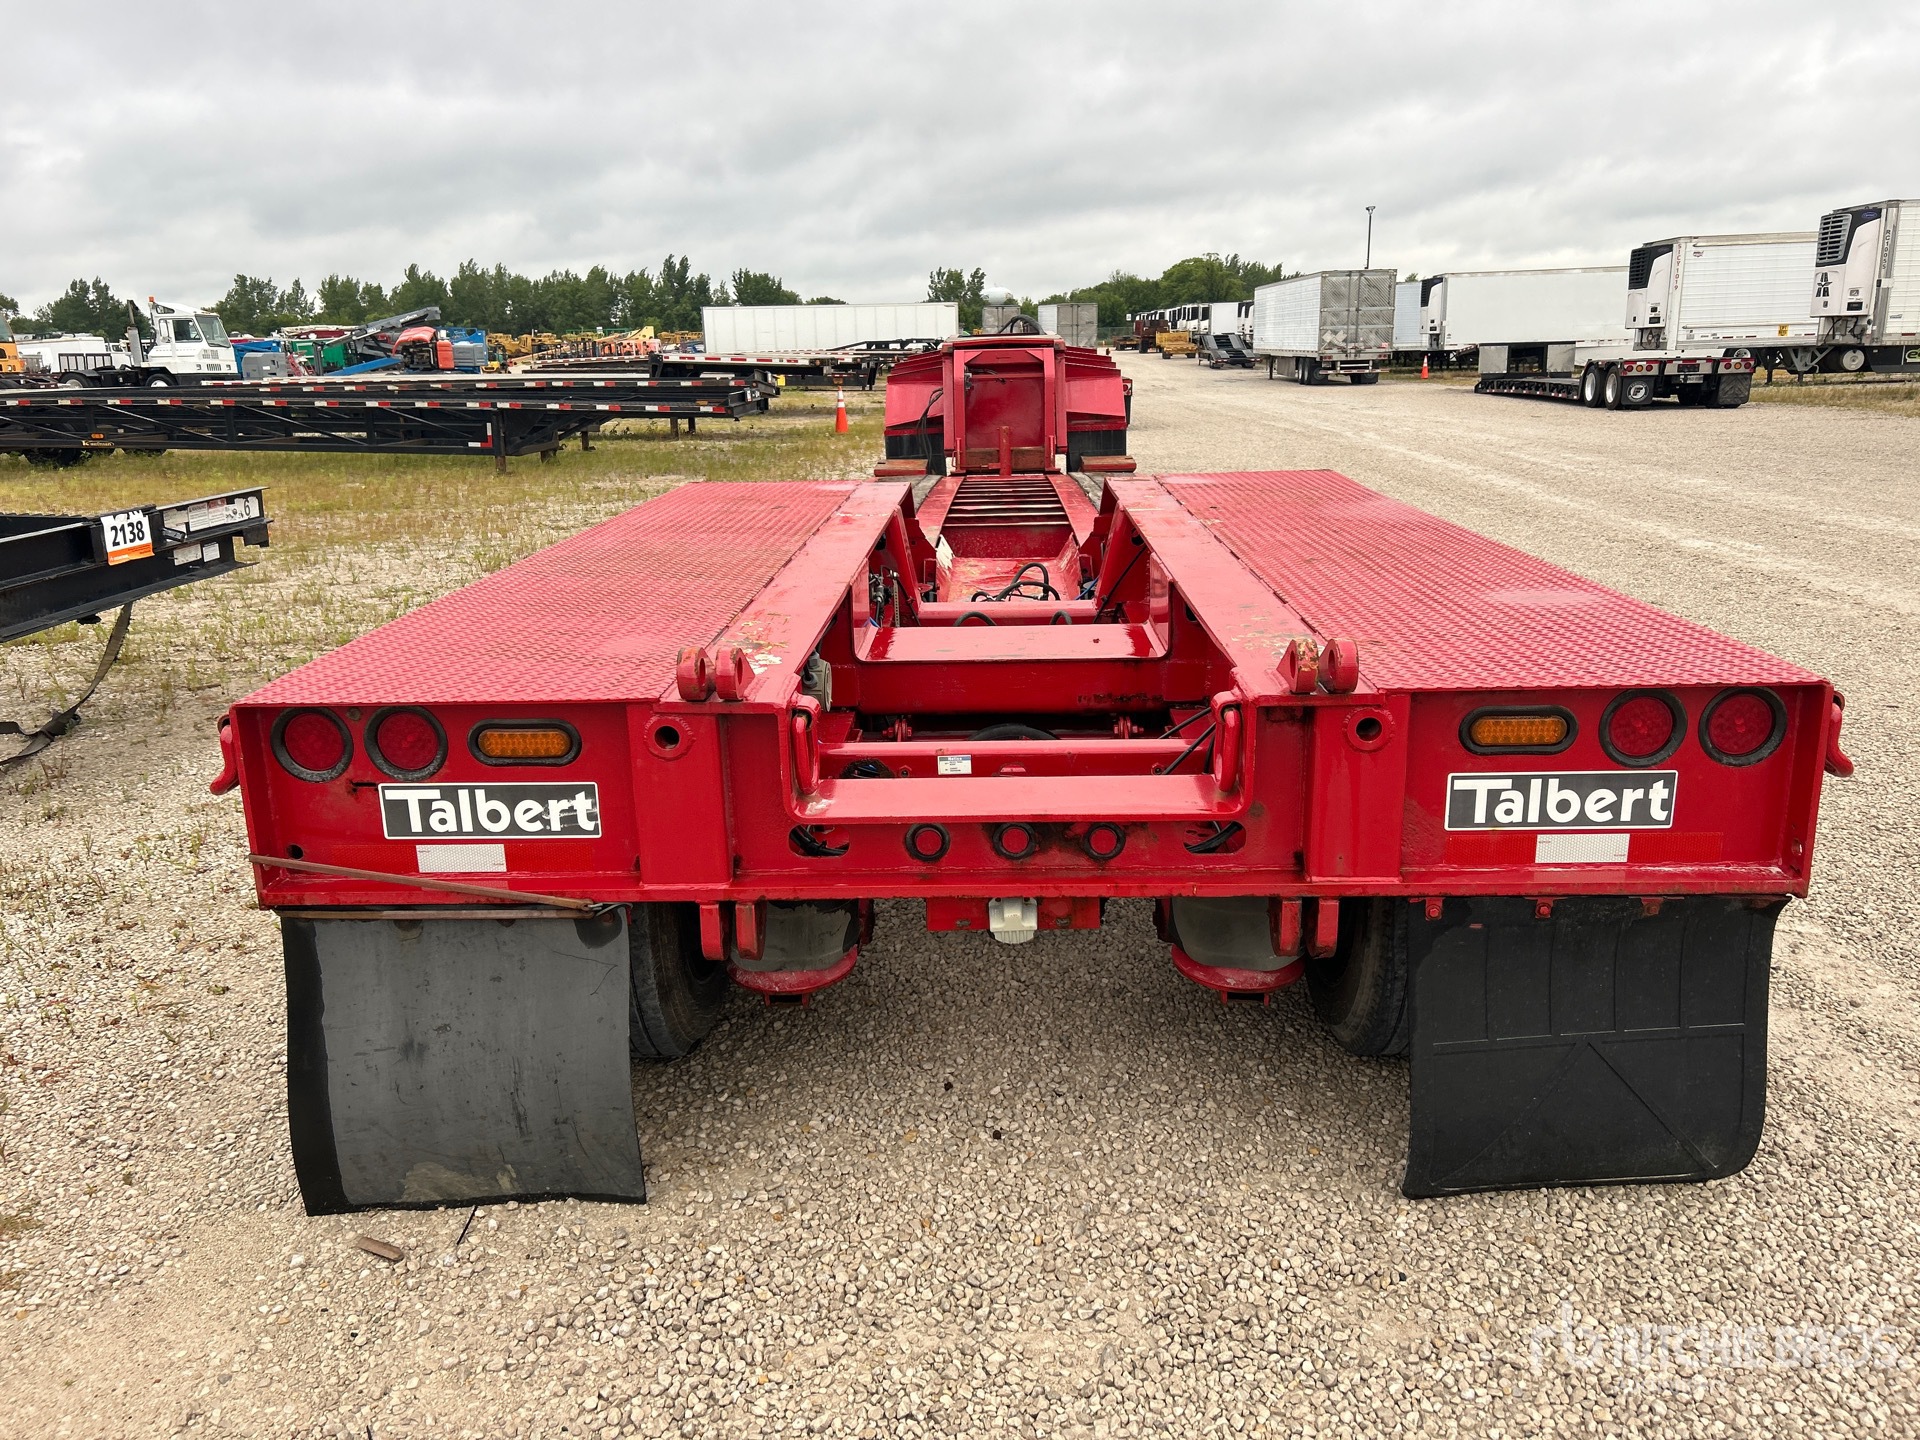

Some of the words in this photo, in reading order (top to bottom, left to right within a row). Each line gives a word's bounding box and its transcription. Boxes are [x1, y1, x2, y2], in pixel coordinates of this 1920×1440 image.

[110, 520, 145, 547] 2138
[384, 788, 596, 833] Talbert
[1453, 778, 1669, 824] Talbert
